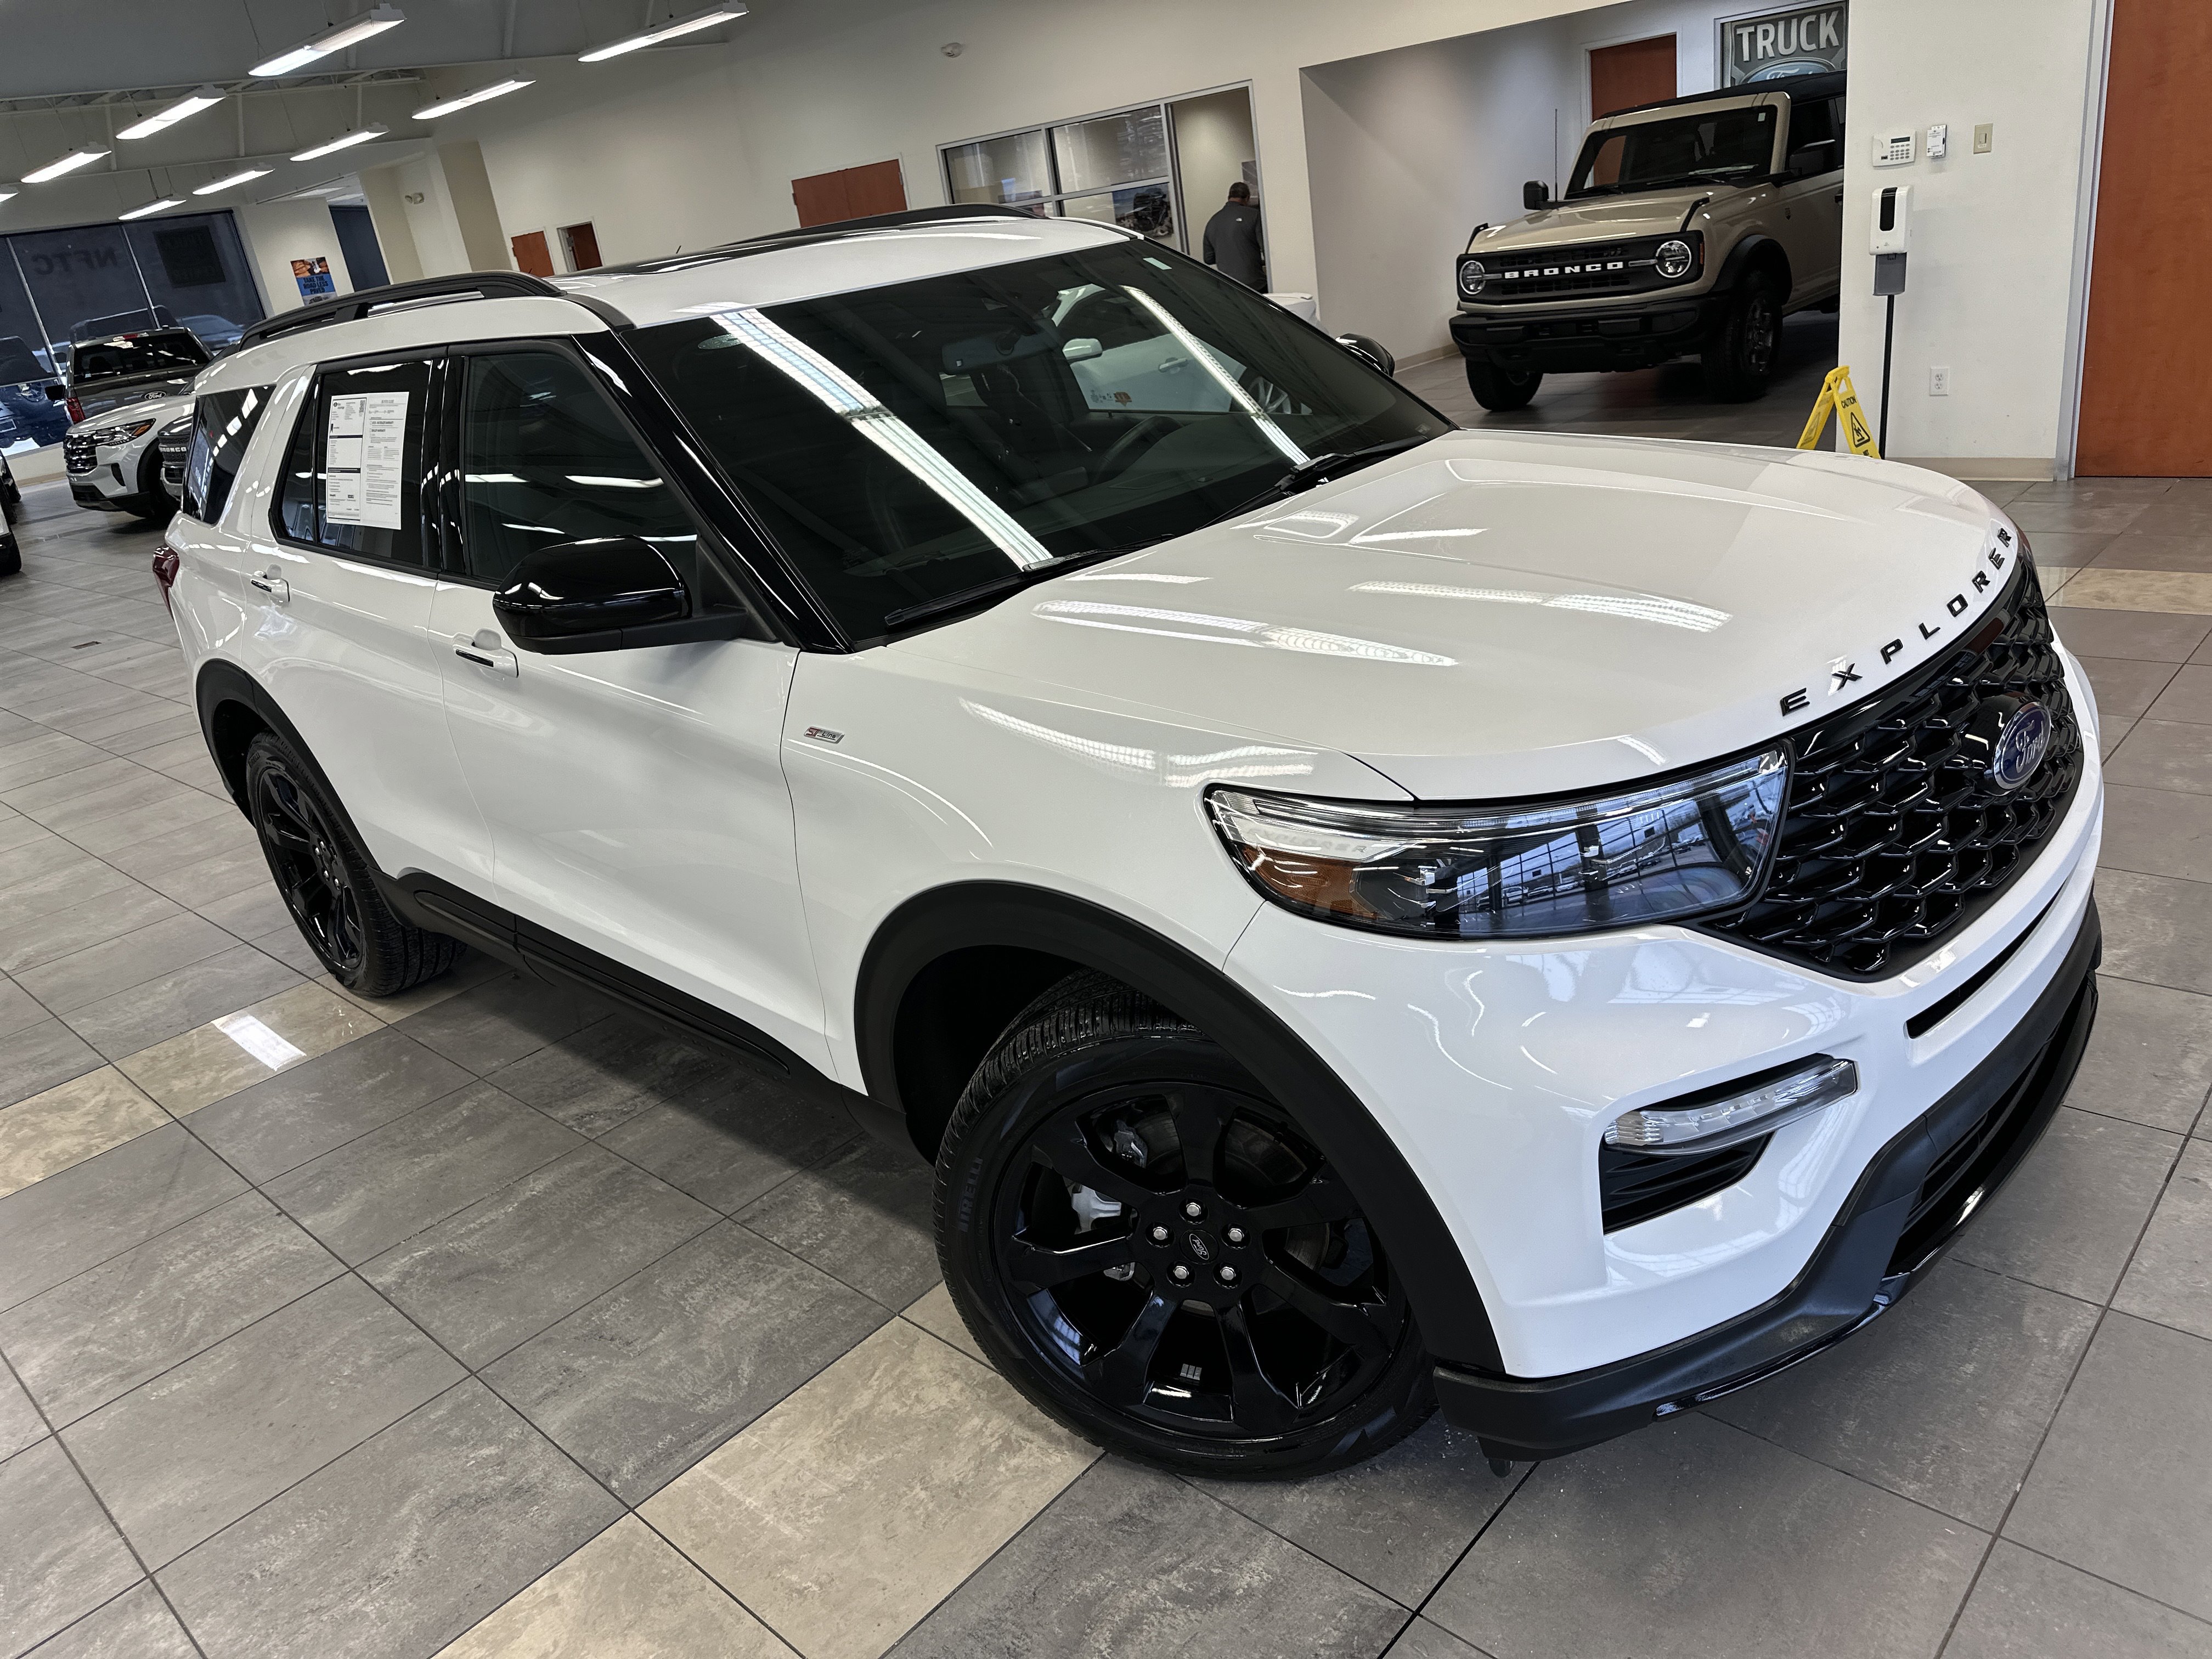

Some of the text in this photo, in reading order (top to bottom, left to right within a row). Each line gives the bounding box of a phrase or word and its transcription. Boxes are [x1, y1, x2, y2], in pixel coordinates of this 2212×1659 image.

[1736, 10, 1840, 62] TRUCK
[1504, 261, 1624, 279] BRONCO
[1841, 395, 1857, 409] CAUTION
[1780, 527, 2012, 717] EXPLORER
[2016, 719, 2046, 774] Ford
[1192, 1239, 1207, 1256] Ford
